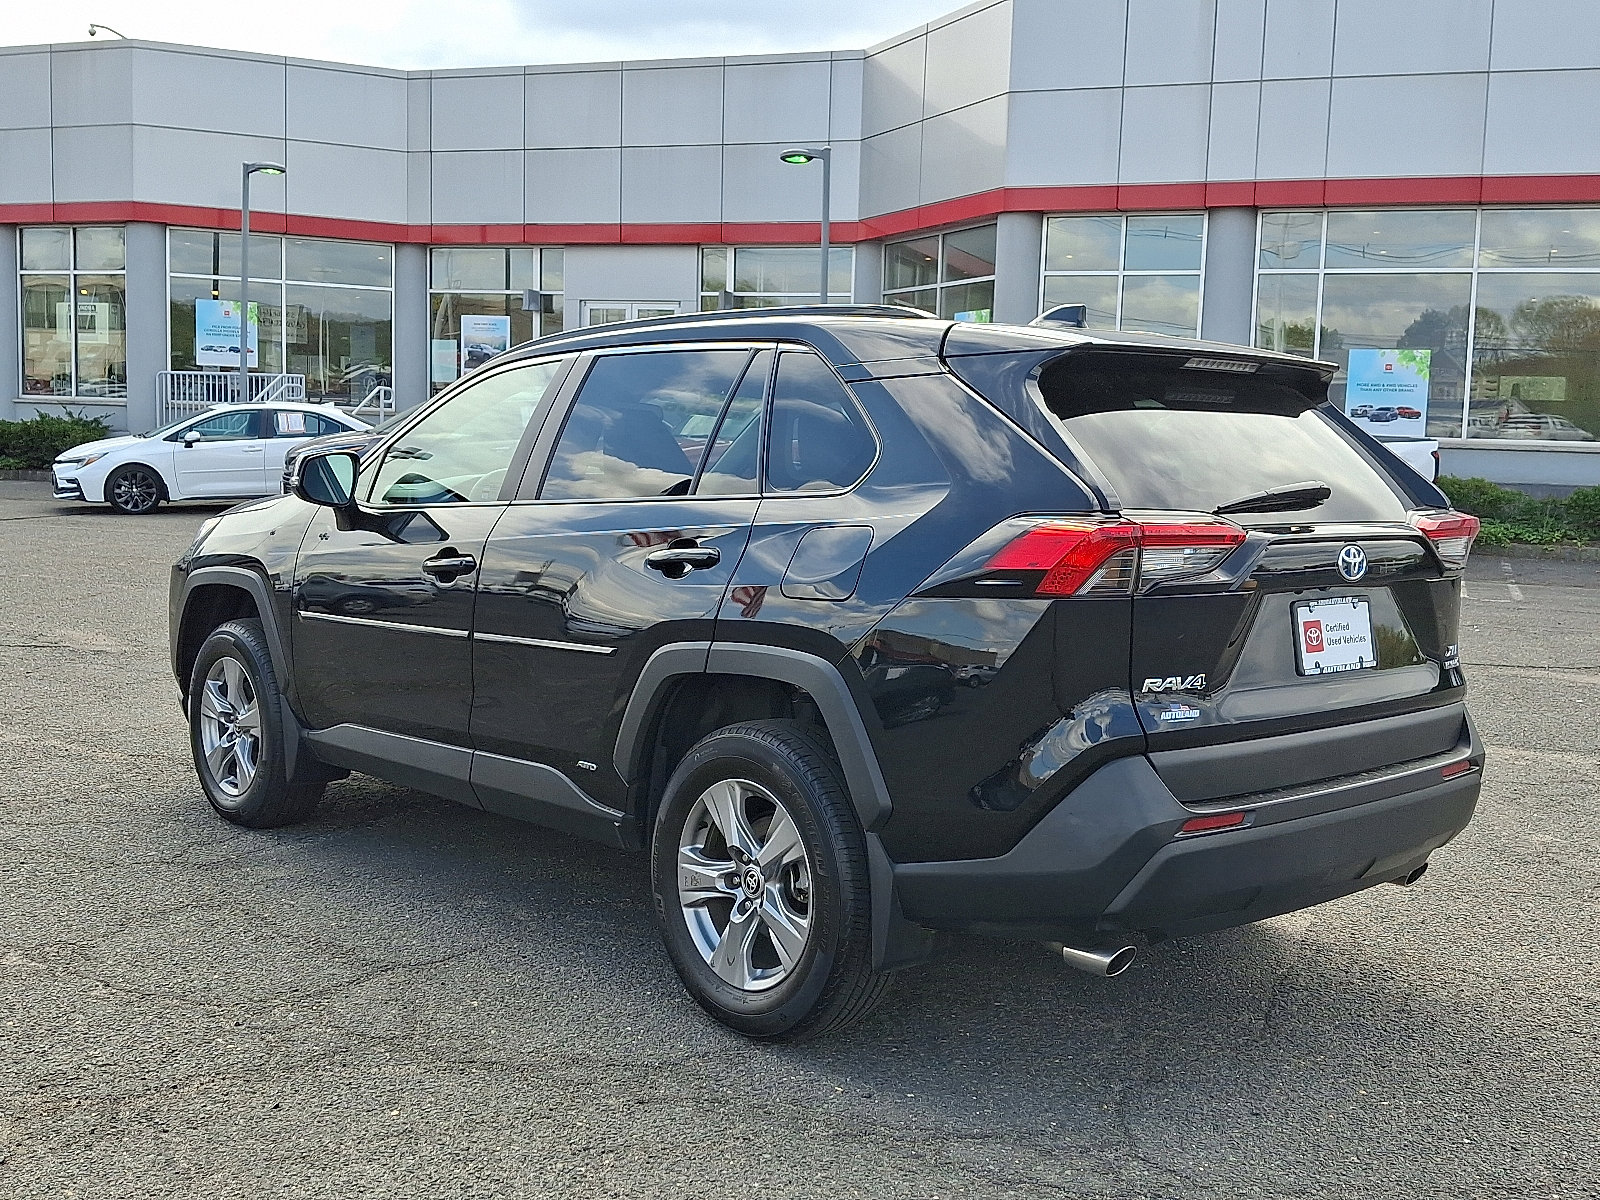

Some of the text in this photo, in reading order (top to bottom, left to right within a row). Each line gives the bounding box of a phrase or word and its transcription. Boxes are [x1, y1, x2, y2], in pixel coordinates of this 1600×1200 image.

[1325, 622, 1350, 633] Certified
[1326, 634, 1367, 646] Used Vehicles
[1322, 662, 1361, 674] AUTOLAND
[1141, 673, 1207, 694] RAV4
[1160, 709, 1200, 720] AUTOLAND
